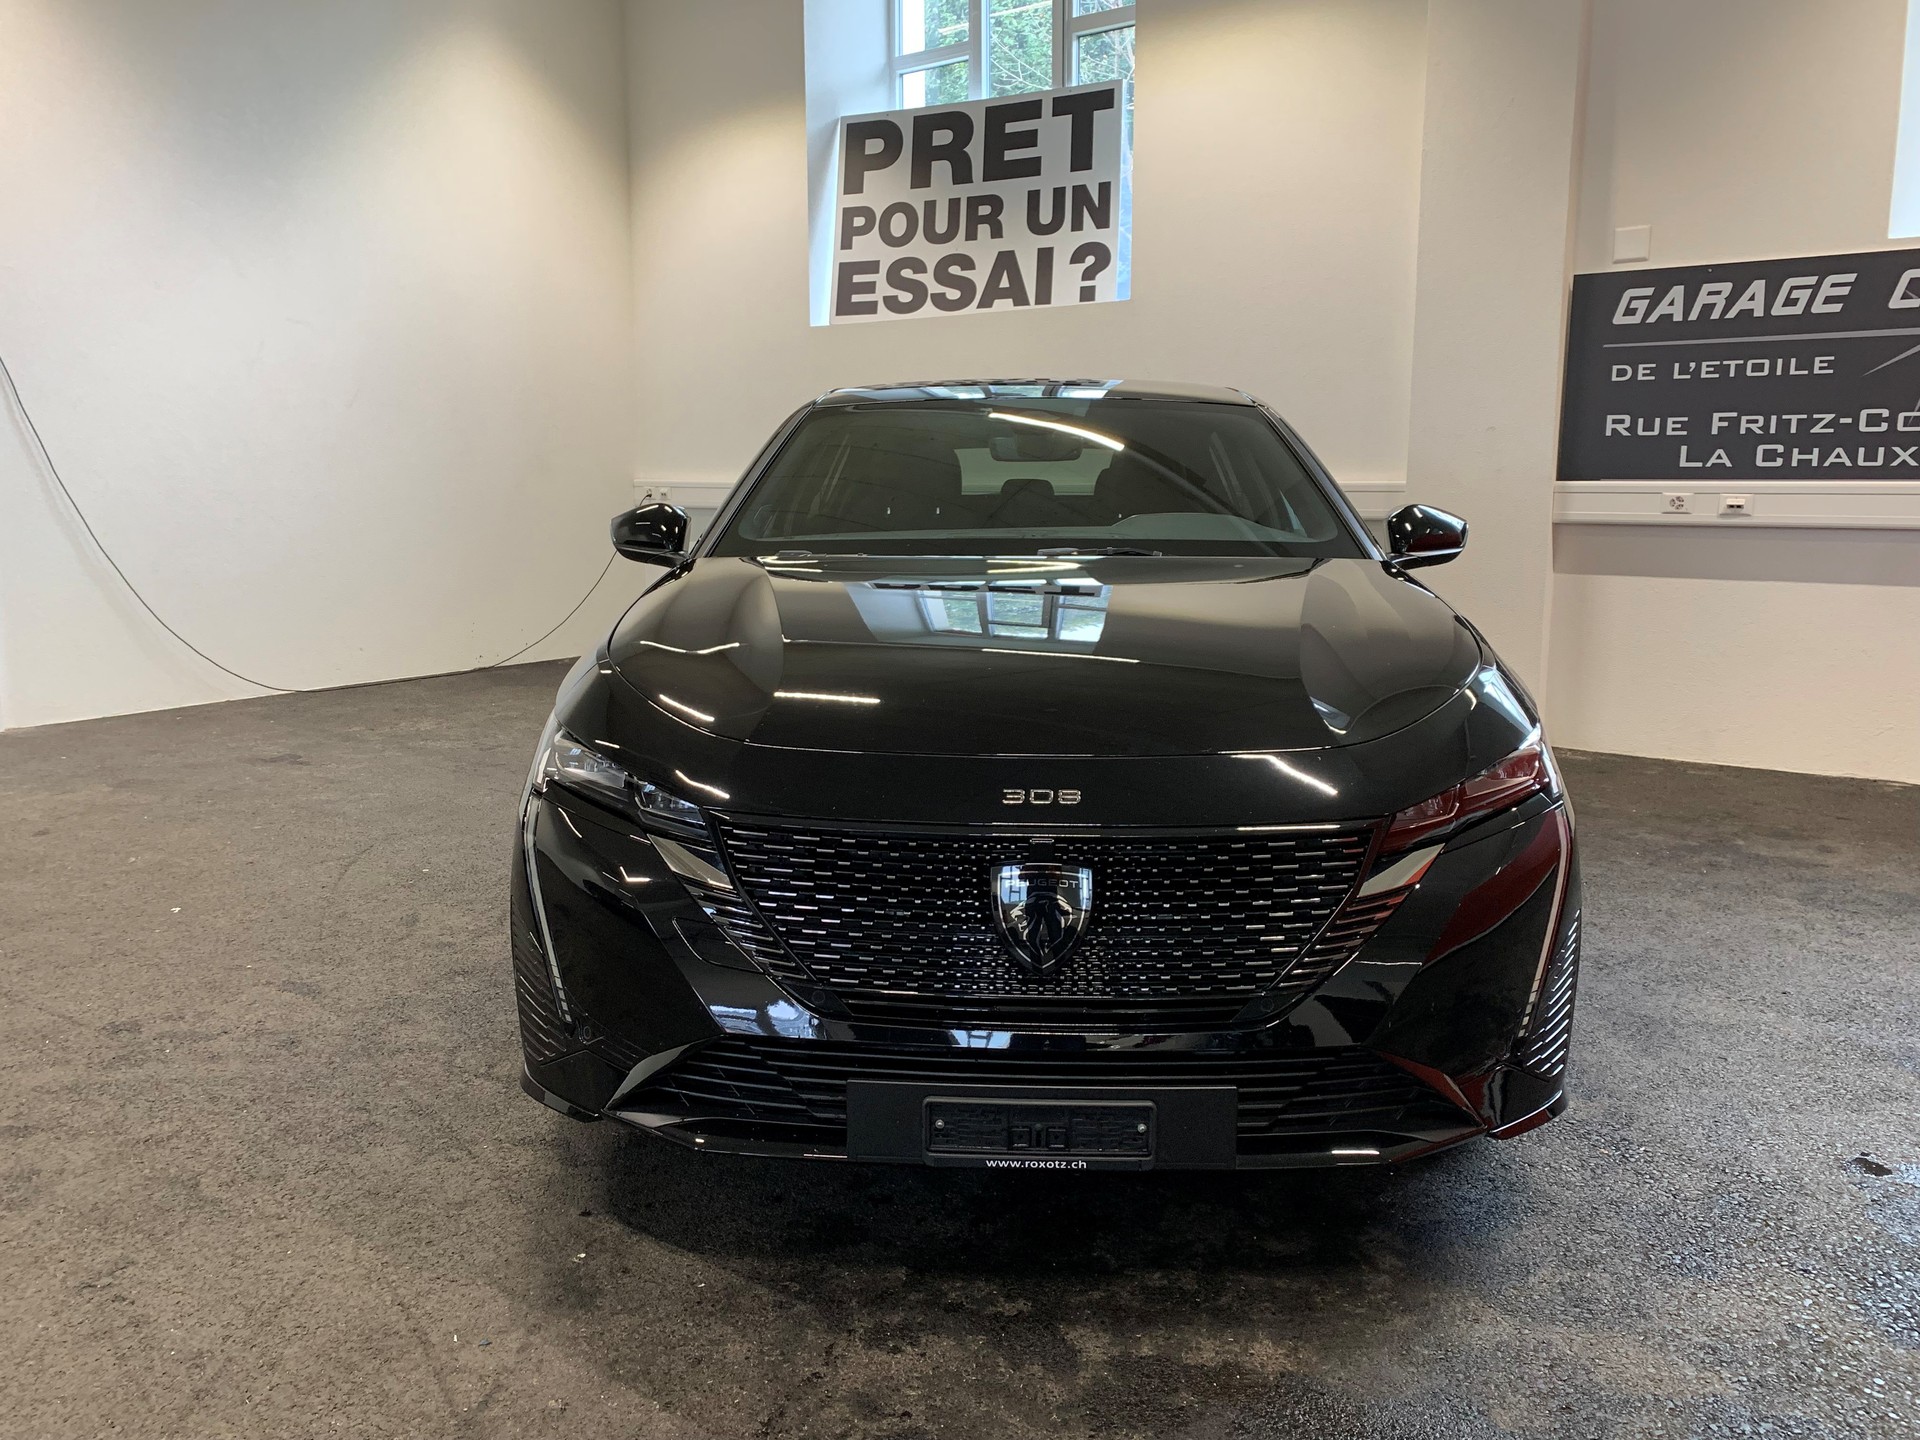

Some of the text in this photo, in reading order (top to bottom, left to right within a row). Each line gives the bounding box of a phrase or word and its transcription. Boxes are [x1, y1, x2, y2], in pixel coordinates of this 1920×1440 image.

[843, 88, 1115, 195] PRET
[840, 181, 1111, 250] POUR UN
[1612, 273, 1858, 325] GARAGE
[1611, 356, 1835, 382] DE L'ETOILE
[1605, 414, 1689, 436] RUE
[1679, 445, 1733, 468] LA
[1002, 788, 1081, 805] 308
[1004, 878, 1079, 889] PEUGEOT
[985, 1159, 1087, 1169] www.roxotz.ch
